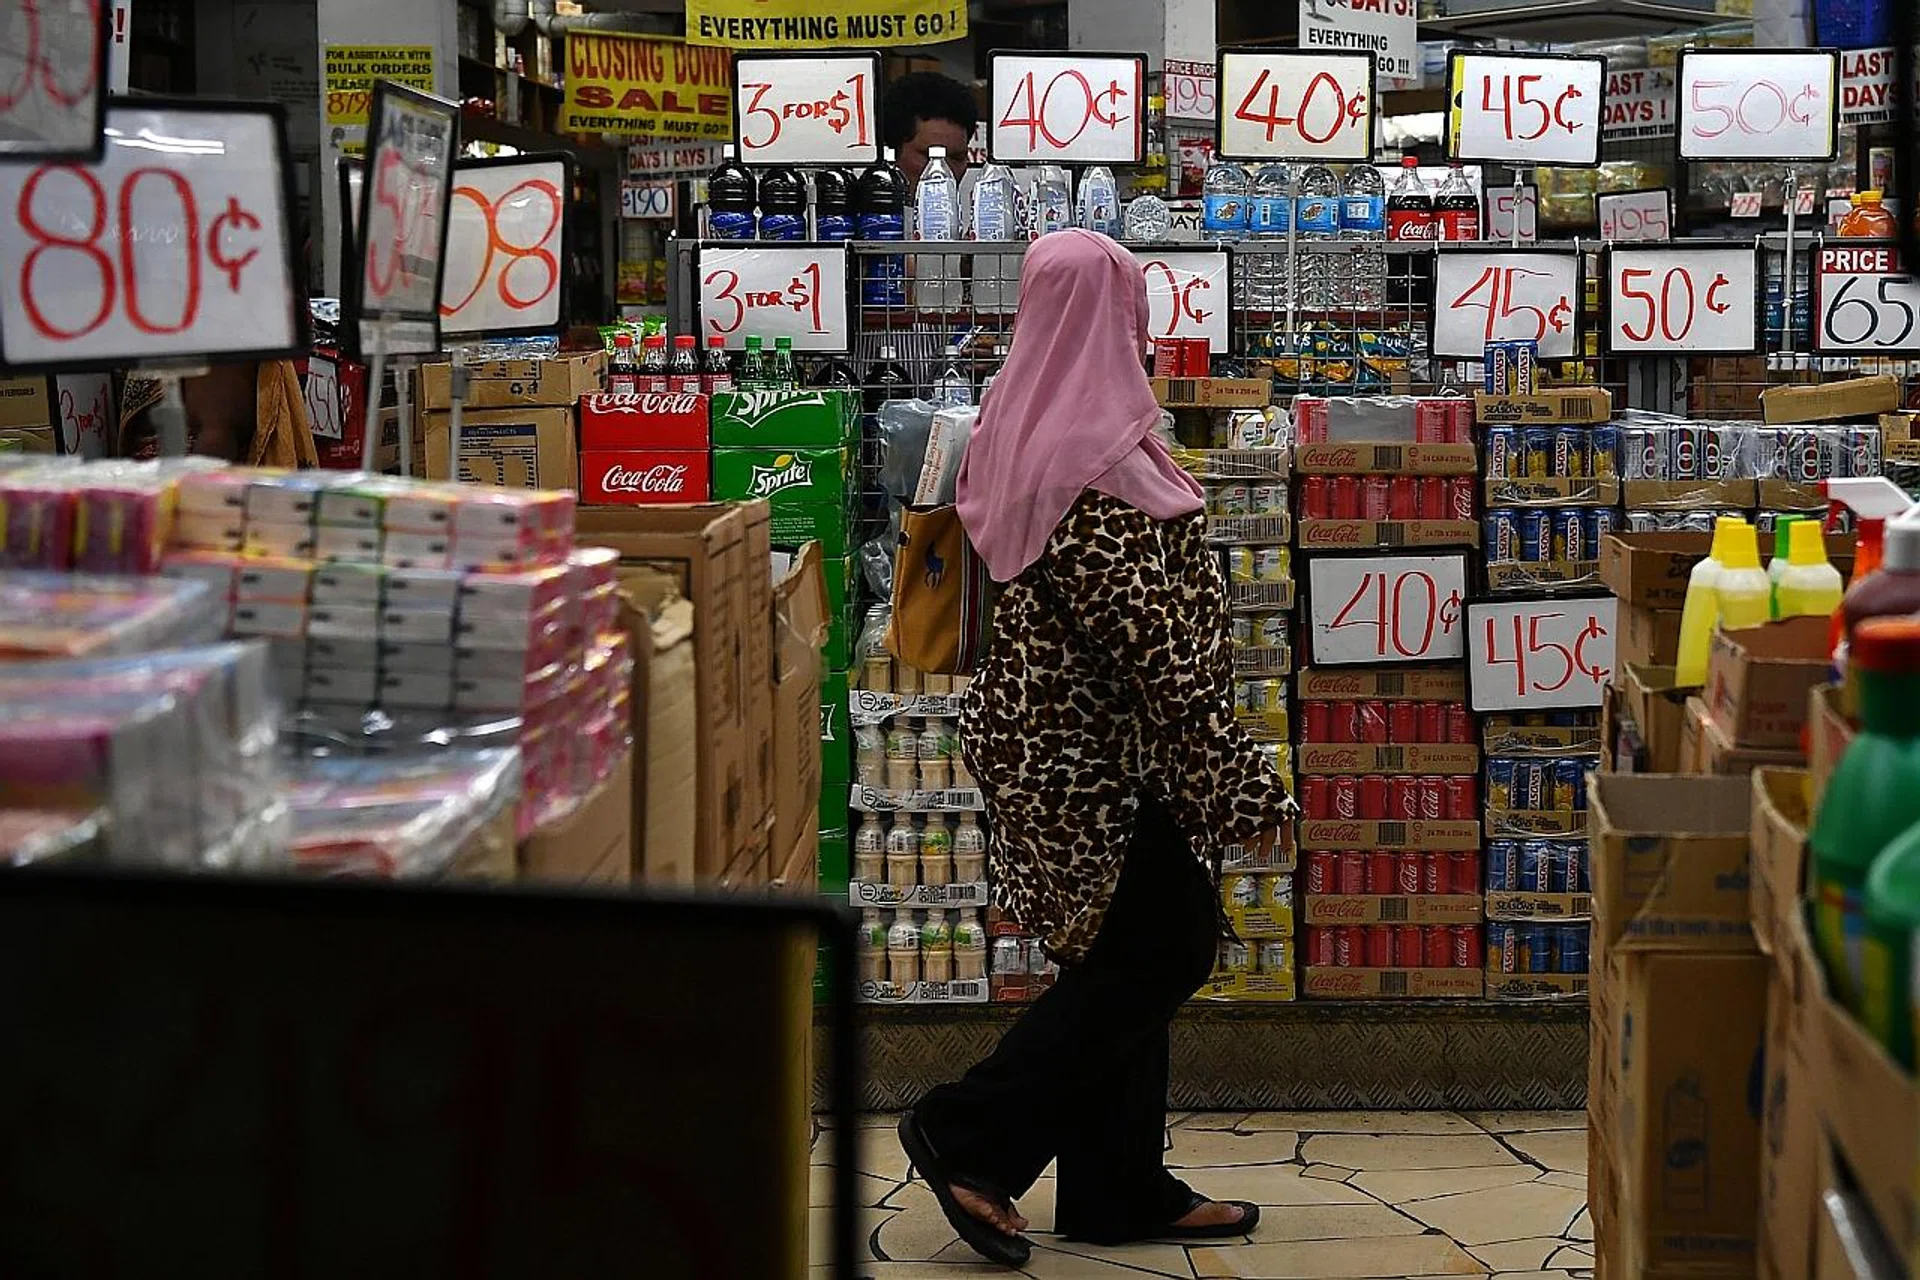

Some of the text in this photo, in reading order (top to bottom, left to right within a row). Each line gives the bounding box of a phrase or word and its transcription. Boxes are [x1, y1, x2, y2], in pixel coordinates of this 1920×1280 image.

[700, 15, 838, 40] EVERYTHING
[847, 14, 905, 38] MUST
[914, 12, 943, 34] GO
[1308, 27, 1388, 51] EVERYTHING
[327, 63, 432, 74] BULK ORDERS
[570, 36, 732, 88] CLOSING DOWN
[1378, 57, 1394, 72] GO
[1842, 51, 1894, 78] LAST
[574, 85, 728, 116] SALE
[1609, 72, 1644, 97] AST
[570, 114, 656, 132] EVERYTHING
[664, 120, 699, 133] MUST
[741, 73, 871, 149] 3 FOR $1
[999, 69, 1130, 152] 40¢
[1234, 69, 1367, 143] 40¢
[1481, 73, 1583, 141] 45¢
[1691, 78, 1819, 139] 50¢
[630, 150, 660, 169] DAYS
[674, 148, 705, 168] DAYS
[17, 160, 262, 341] 80¢
[1822, 250, 1888, 271] PRICE
[704, 269, 744, 333] 3
[785, 262, 830, 334] $1
[1449, 266, 1573, 341] 45¢
[1620, 267, 1731, 342] 50¢
[1825, 275, 1914, 346] 65
[1484, 404, 1523, 414] SEASONS
[602, 464, 687, 493] Coca-Cola
[754, 462, 806, 494] Sprite
[1329, 571, 1462, 657] 40¢
[1485, 612, 1610, 696] 45¢
